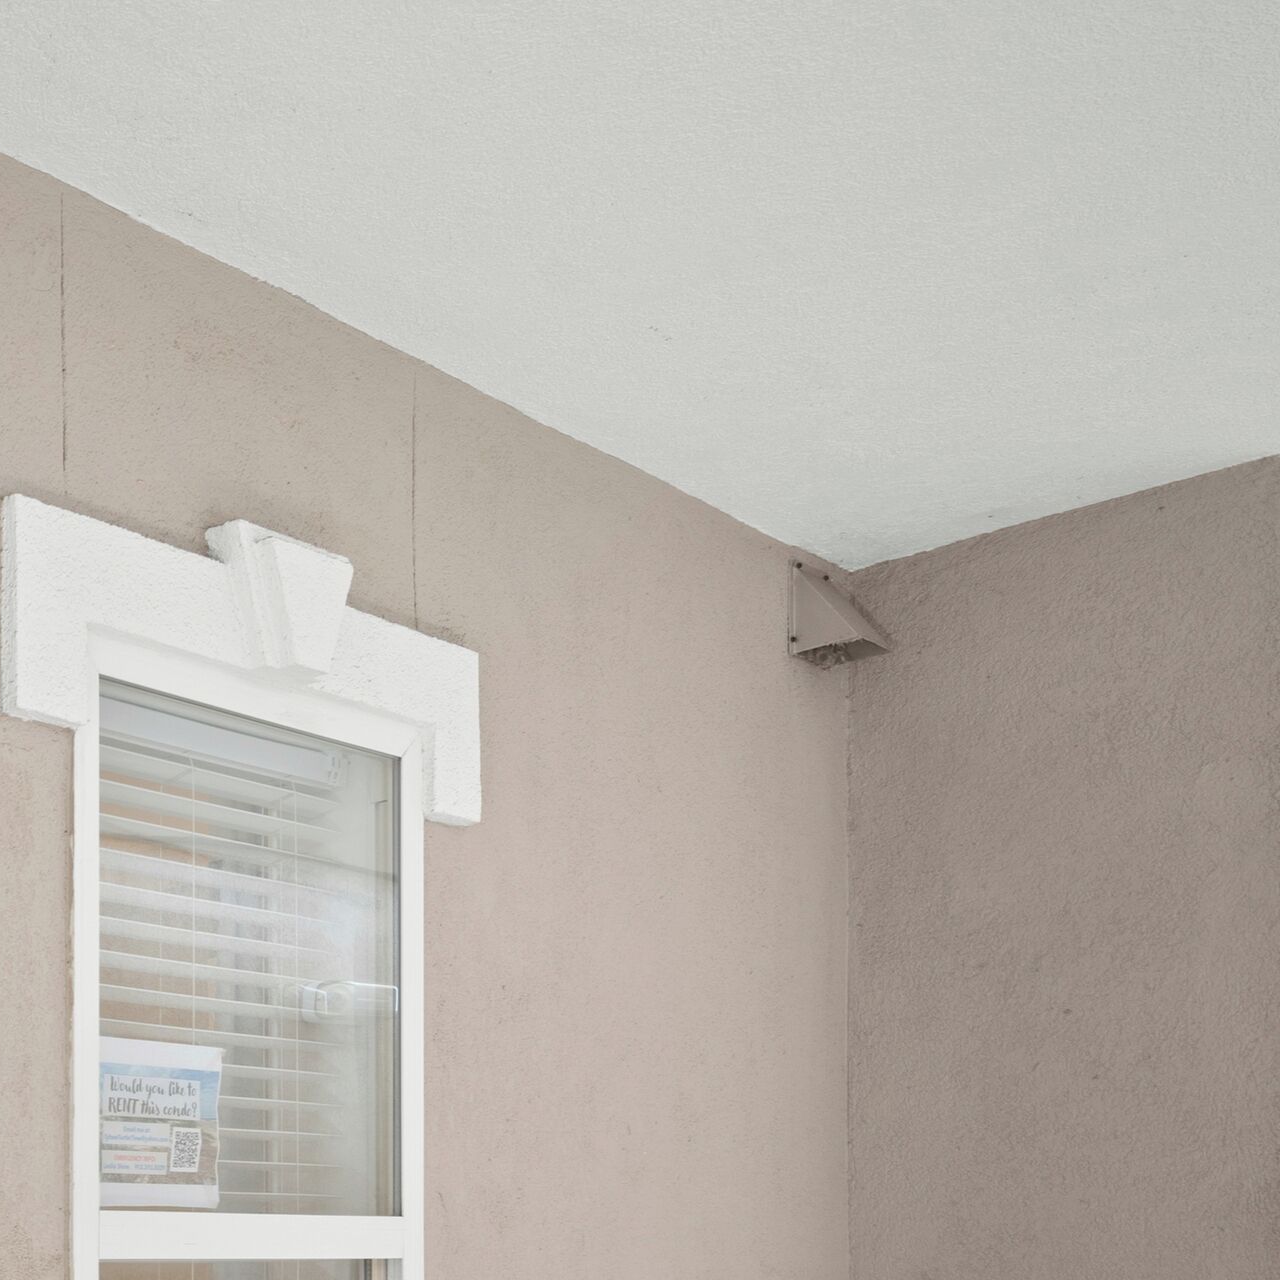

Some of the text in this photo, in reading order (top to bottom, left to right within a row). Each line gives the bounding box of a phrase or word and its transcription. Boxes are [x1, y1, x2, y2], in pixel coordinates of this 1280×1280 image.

[110, 1076, 197, 1100] Would you like to
[108, 1097, 198, 1118] RENT this condo?
